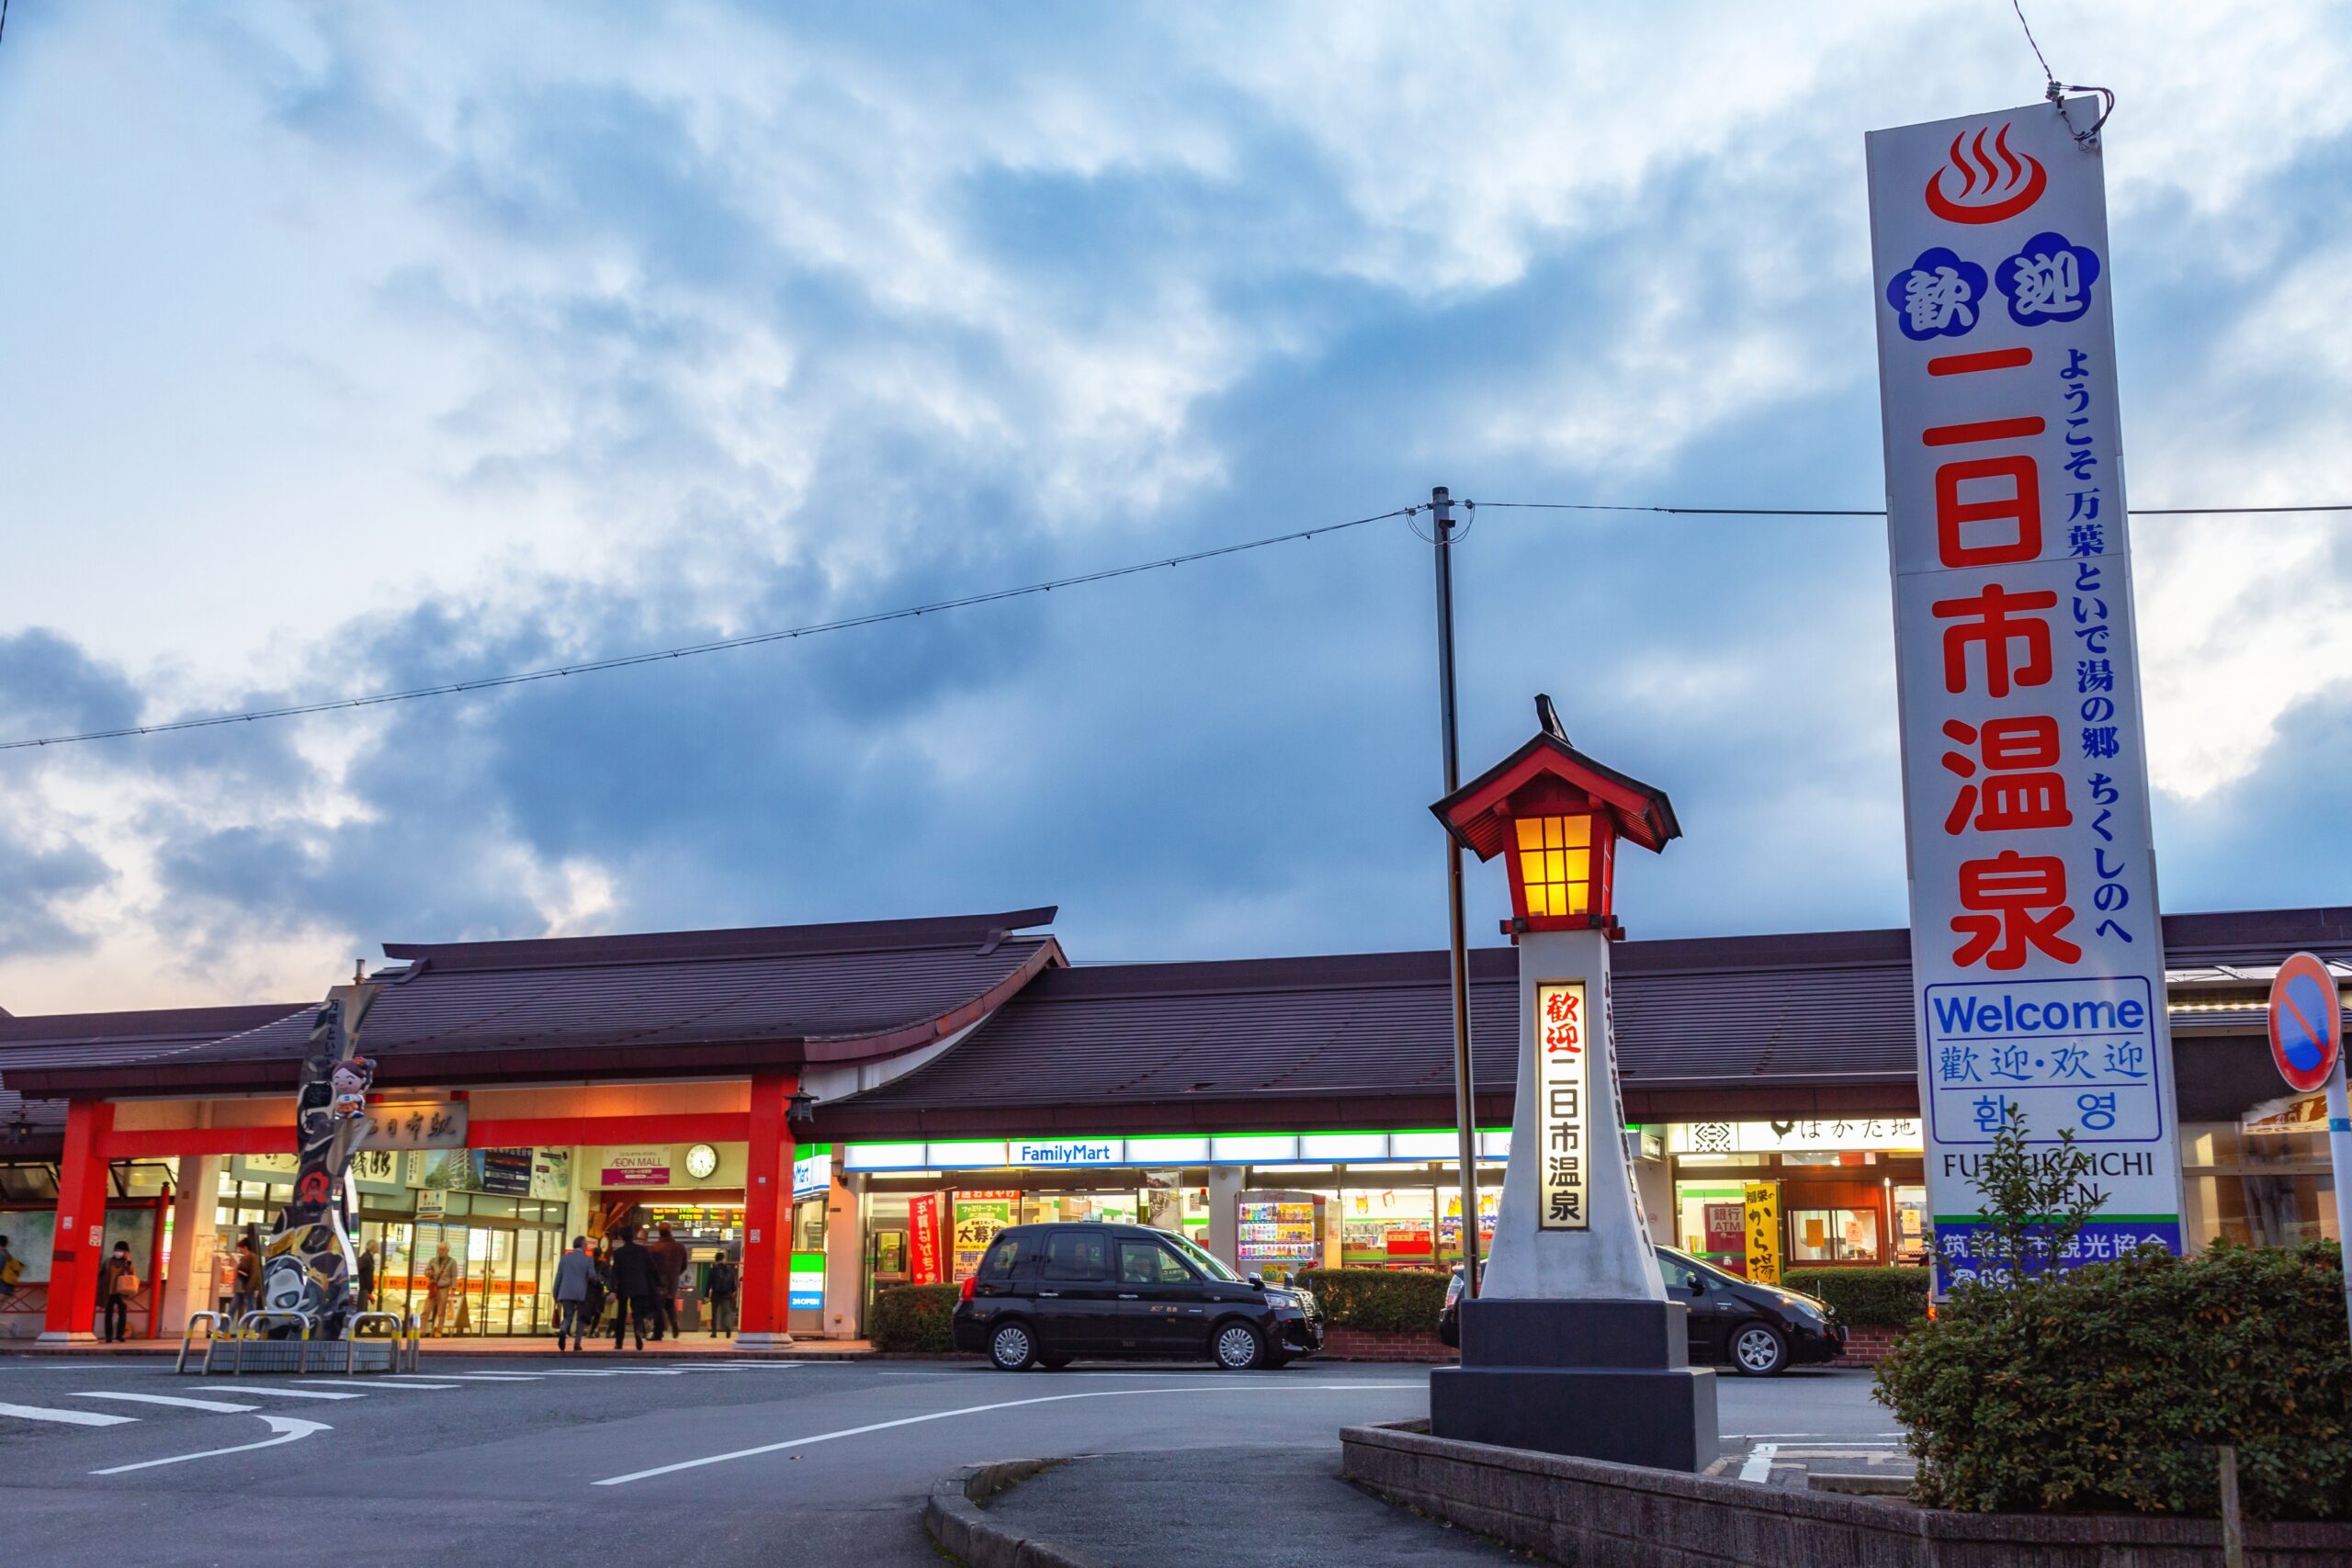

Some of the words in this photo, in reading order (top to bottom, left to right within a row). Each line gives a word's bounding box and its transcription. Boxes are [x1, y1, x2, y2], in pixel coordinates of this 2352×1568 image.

[1922, 346, 2082, 971] 二日市温泉
[1546, 991, 1581, 1054] 歓迎
[1933, 995, 2144, 1034] Welcome
[1548, 1058, 1582, 1221] 二日市温泉
[638, 1156, 662, 1167] MALL
[1022, 1145, 1110, 1163] FamilyMart
[1713, 1208, 1741, 1221] 銀行
[1715, 1223, 1741, 1231] ATM
